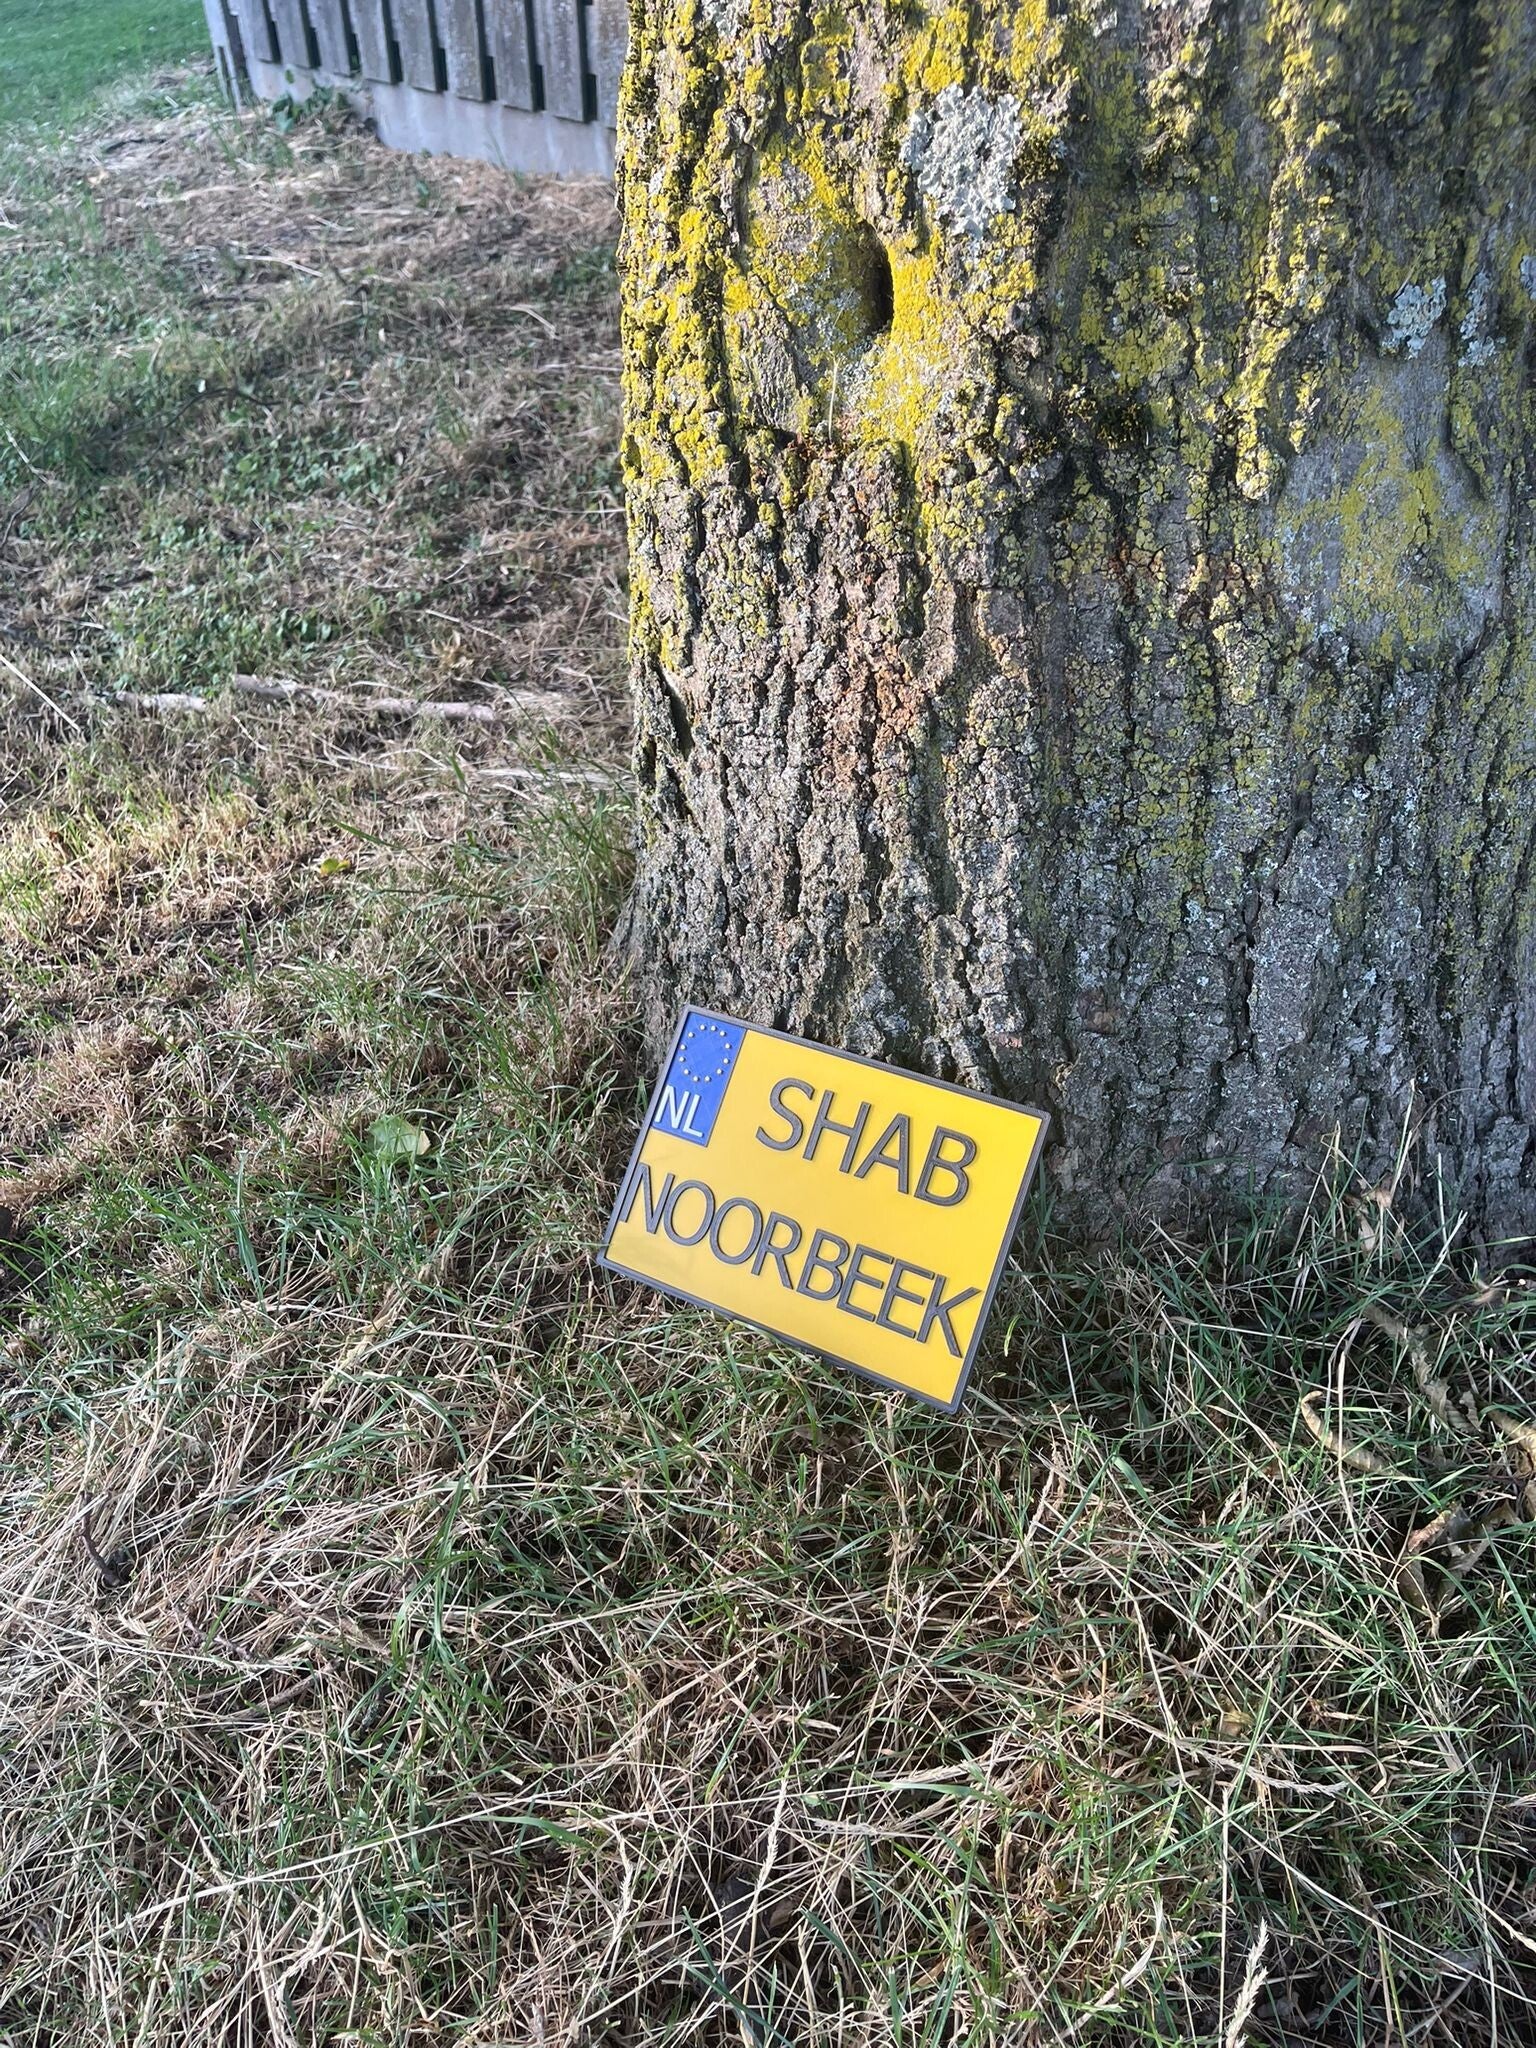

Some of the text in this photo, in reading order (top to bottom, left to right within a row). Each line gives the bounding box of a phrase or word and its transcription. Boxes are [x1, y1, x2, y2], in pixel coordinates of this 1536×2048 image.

[653, 1085, 705, 1139] NL
[755, 1078, 977, 1207] SHAB
[619, 1163, 982, 1359] NOORBEEK
